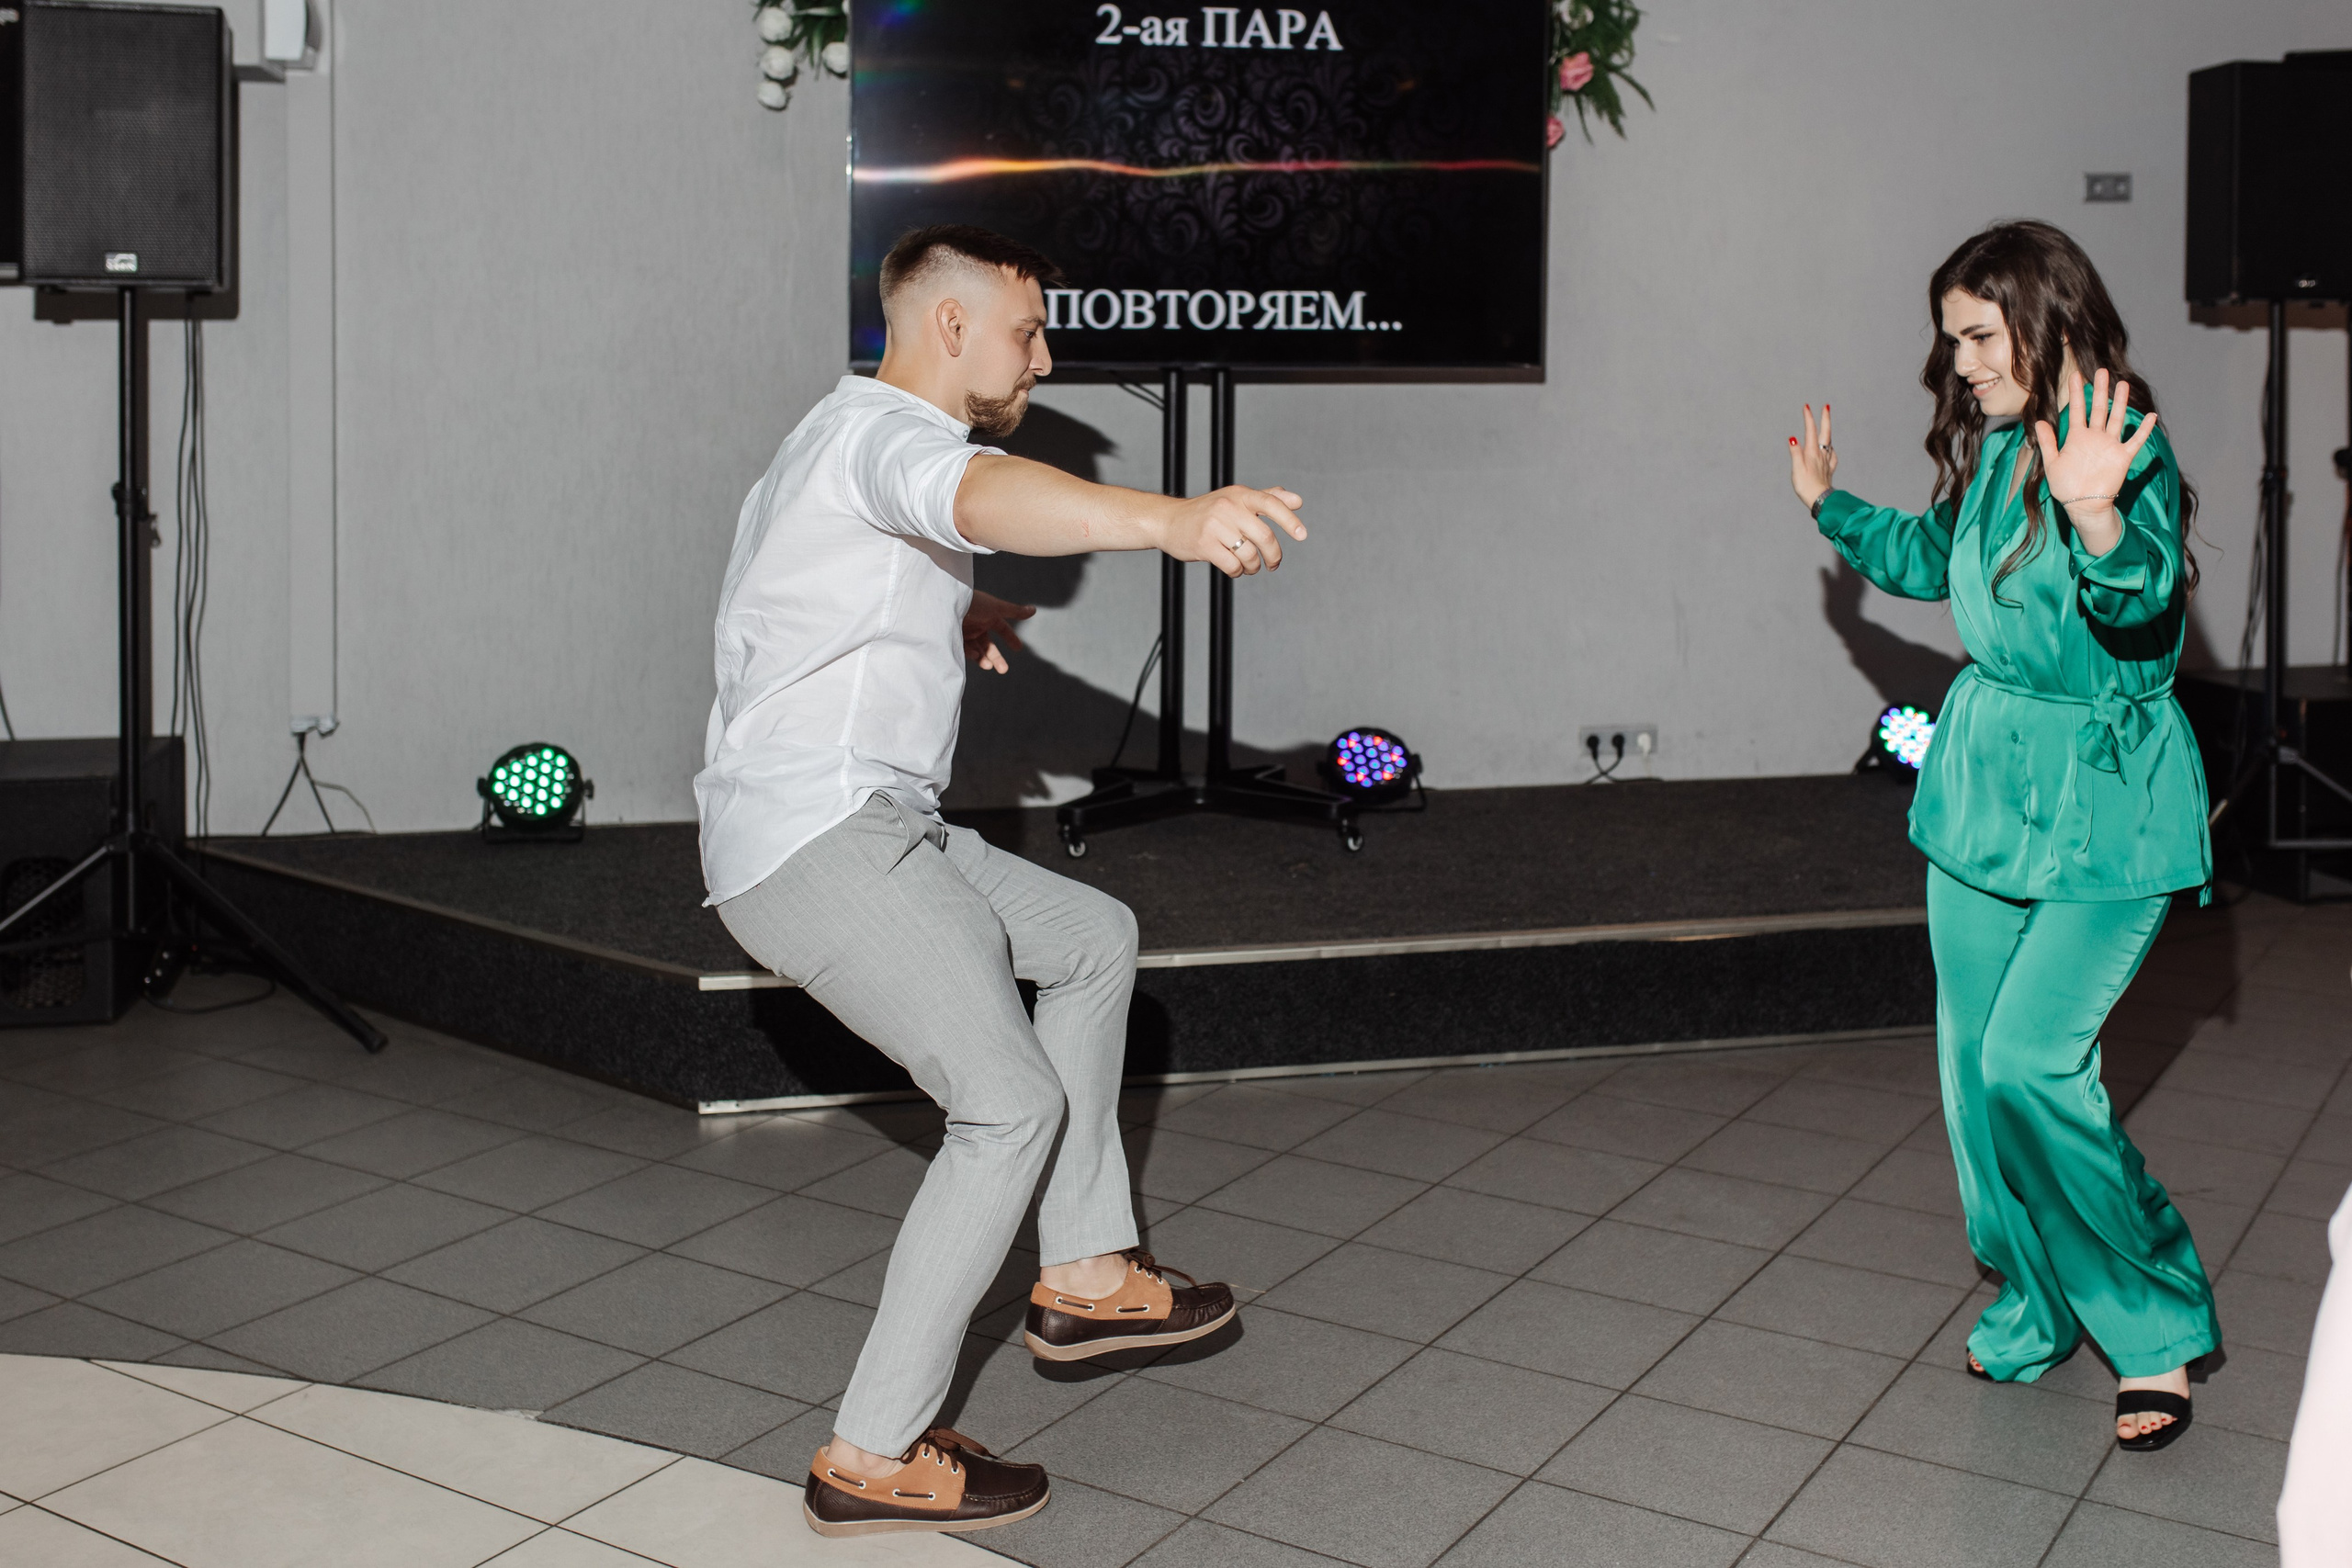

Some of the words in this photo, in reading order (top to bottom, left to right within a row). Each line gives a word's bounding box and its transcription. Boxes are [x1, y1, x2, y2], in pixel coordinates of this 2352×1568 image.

[1095, 3, 1189, 46] 2-ая
[1201, 6, 1343, 50] ПАРА
[1044, 288, 1403, 331] ПОВТОРЯЕМ...
